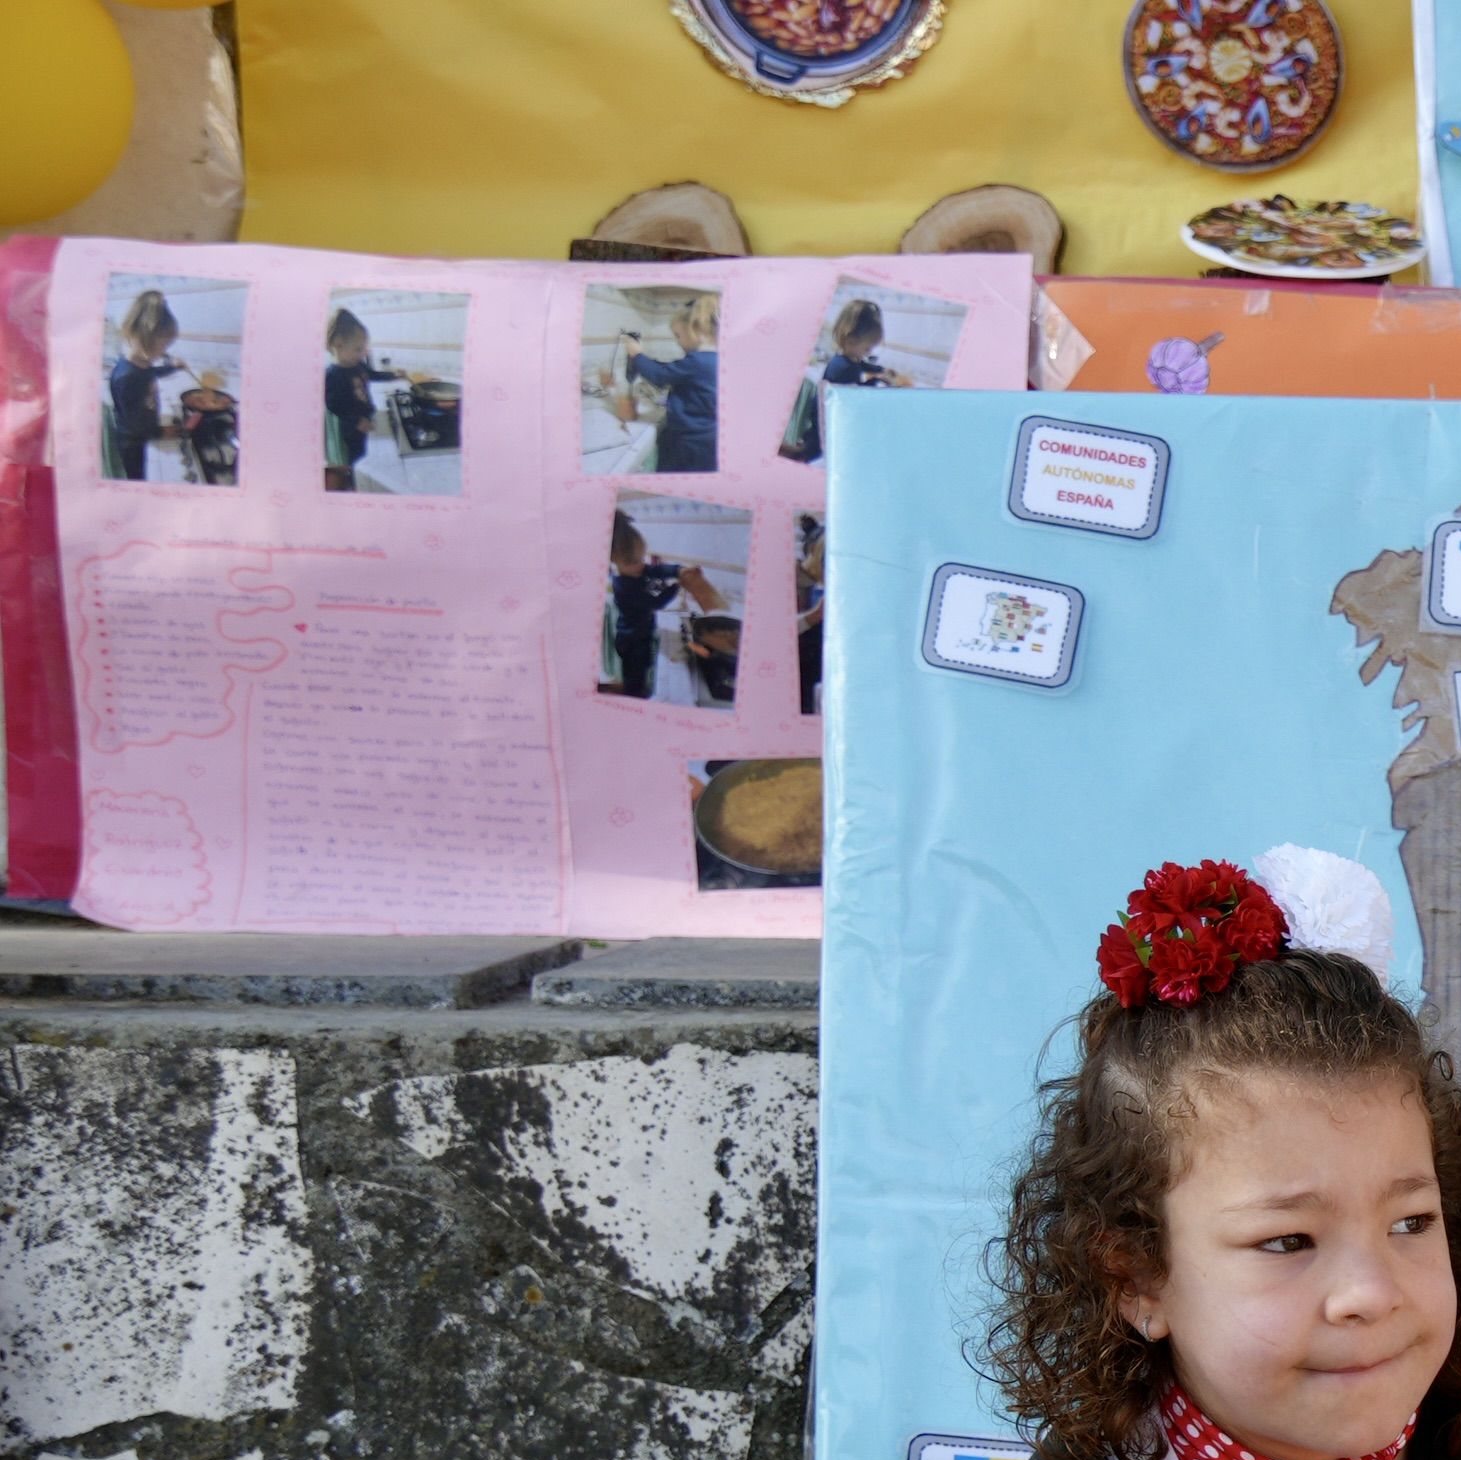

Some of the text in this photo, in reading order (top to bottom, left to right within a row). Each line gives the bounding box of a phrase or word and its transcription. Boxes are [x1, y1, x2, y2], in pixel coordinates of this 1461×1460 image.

[1038, 439, 1148, 470] COMUNIDADES
[1042, 462, 1136, 491] AUTÓNOMAS
[1056, 489, 1114, 511] ESPAÑA
